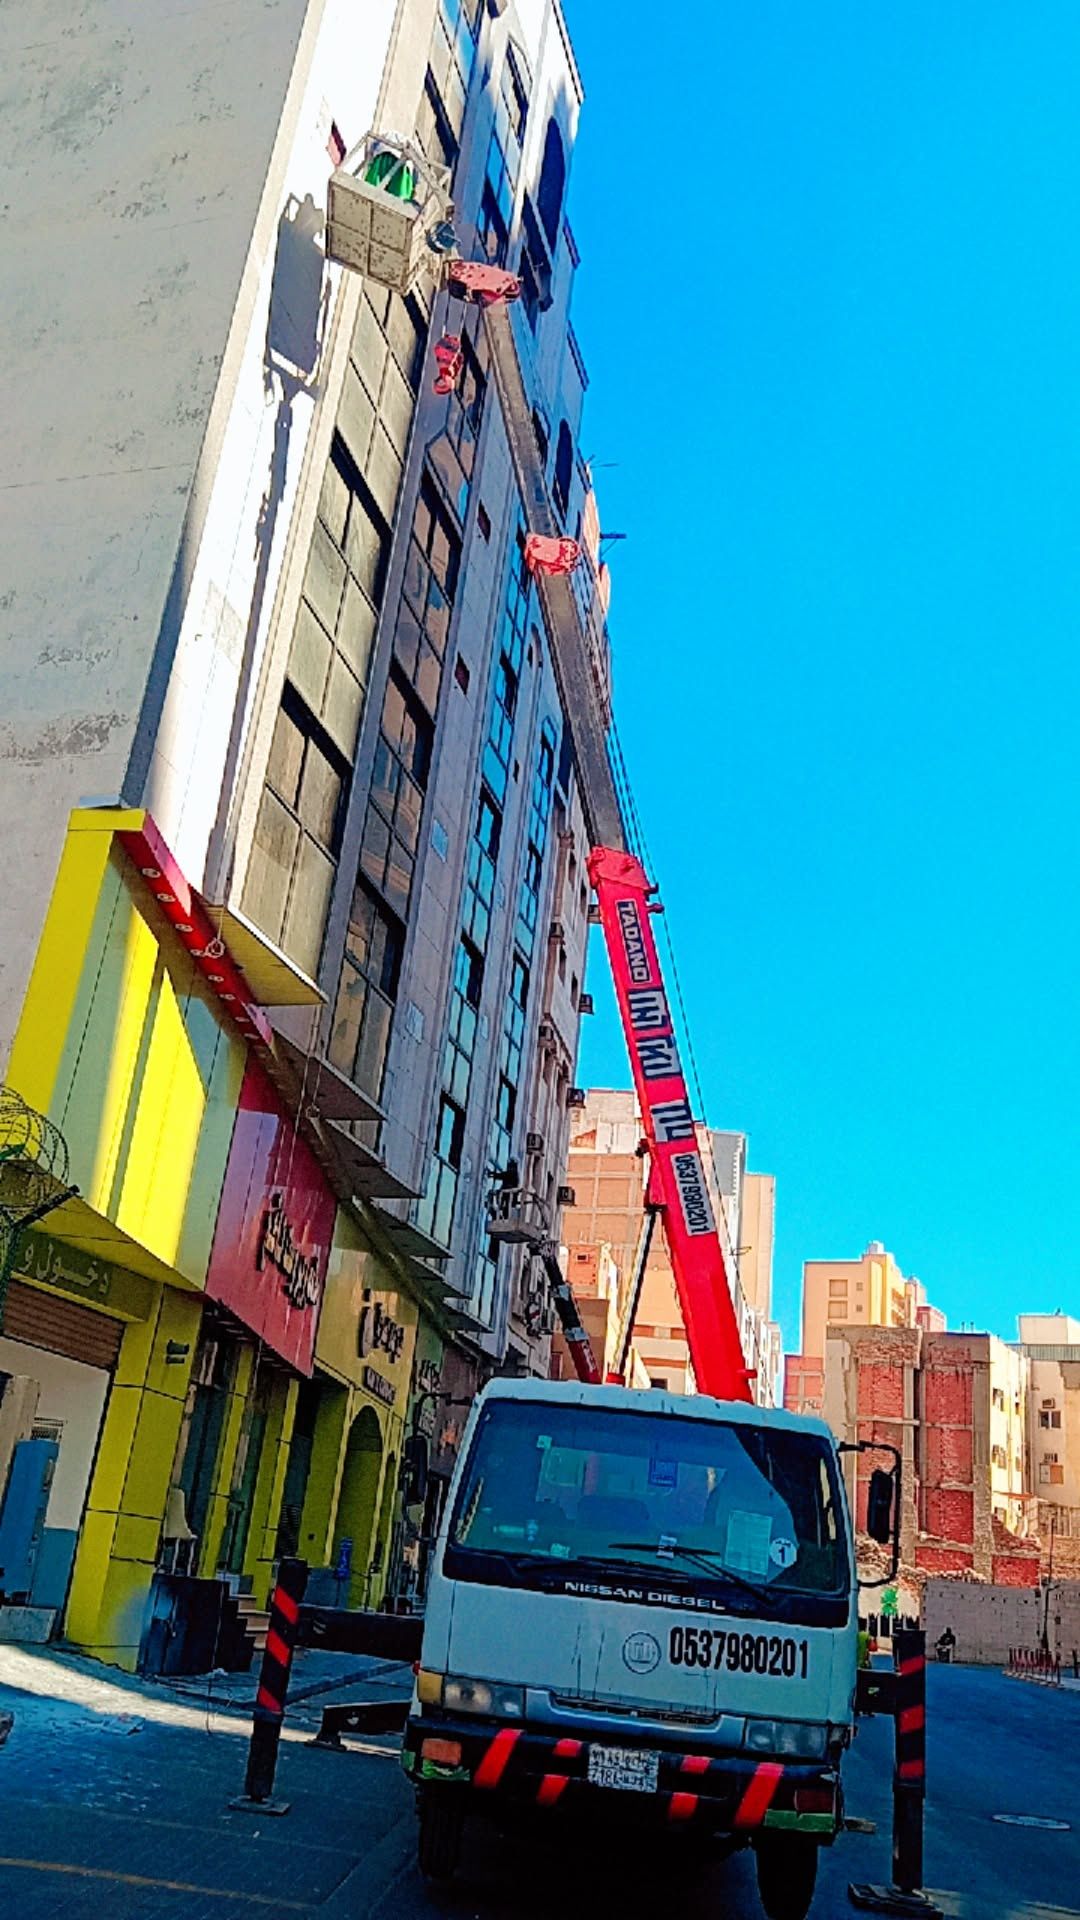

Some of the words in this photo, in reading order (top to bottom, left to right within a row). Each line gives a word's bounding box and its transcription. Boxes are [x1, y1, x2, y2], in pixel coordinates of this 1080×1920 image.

[619, 902, 649, 981] TADANO
[675, 1154, 710, 1233] 0537980201
[565, 1581, 642, 1599] NISSAN
[648, 1592, 725, 1610] DIESEL
[669, 1627, 808, 1679] 0537980201
